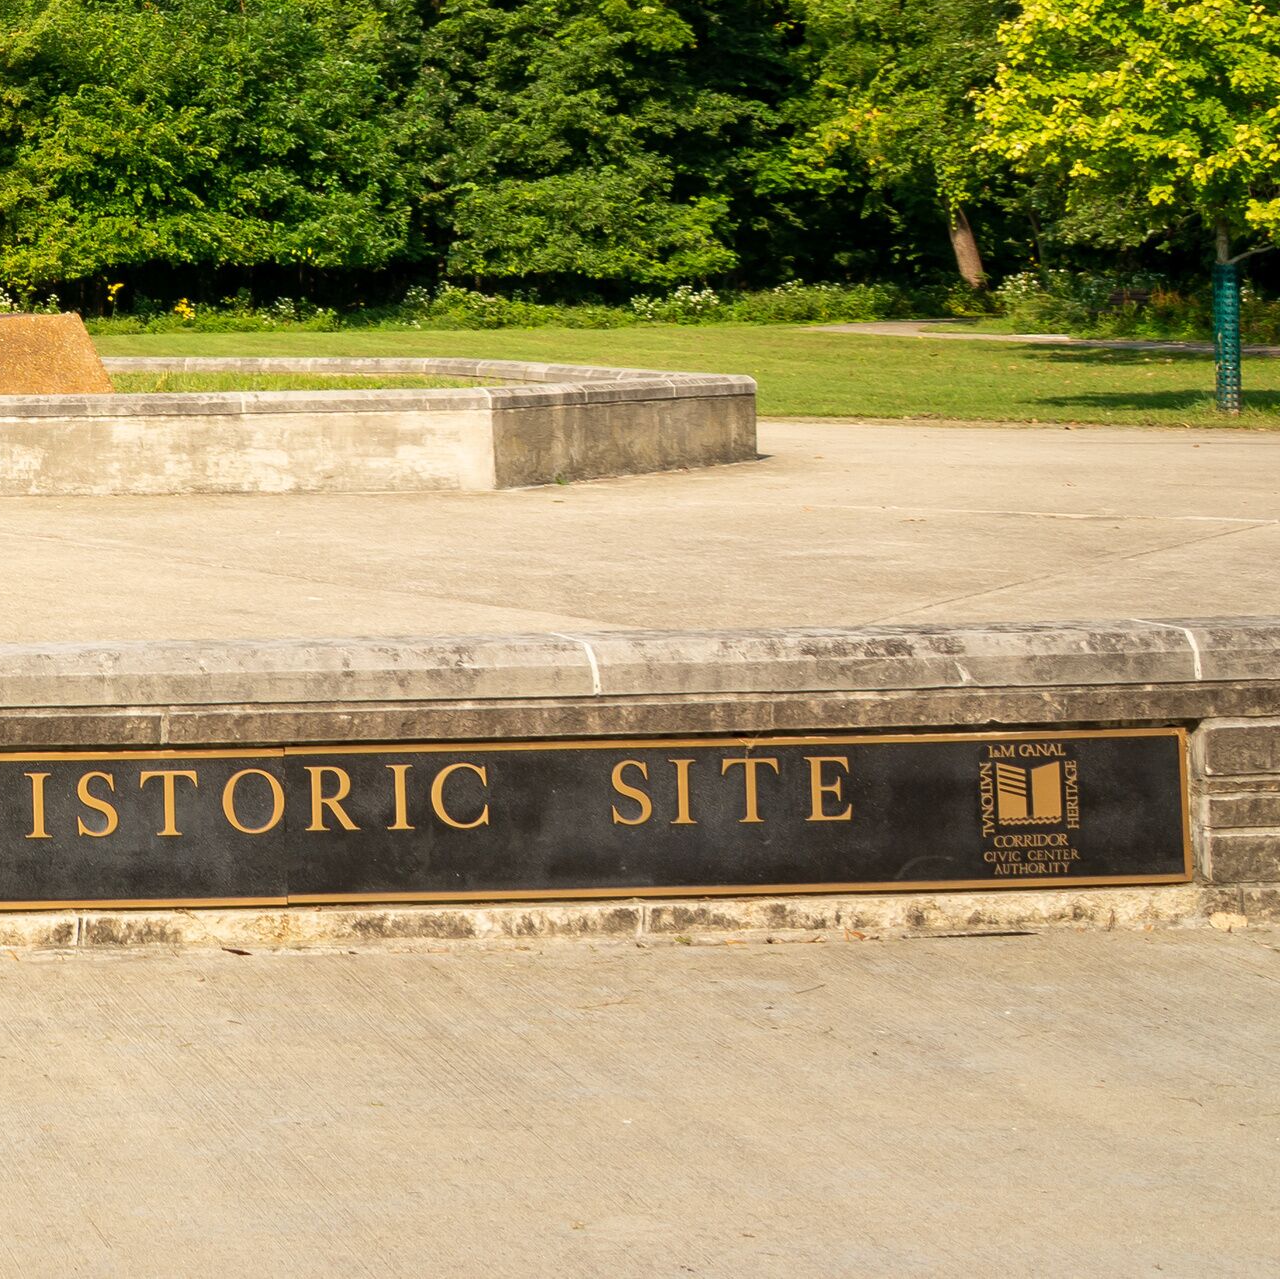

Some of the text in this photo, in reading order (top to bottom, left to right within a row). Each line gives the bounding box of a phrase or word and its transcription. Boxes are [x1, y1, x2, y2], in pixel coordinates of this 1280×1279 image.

[988, 744, 1066, 758] I&M CANAL
[610, 756, 854, 827] SITE
[1064, 760, 1080, 829] HERITAGE
[979, 762, 996, 837] NATIONAL
[994, 833, 1069, 848] CORRIDOR
[984, 848, 1080, 863] CIVIC CENTER
[995, 862, 1071, 875] AUTHORITY
